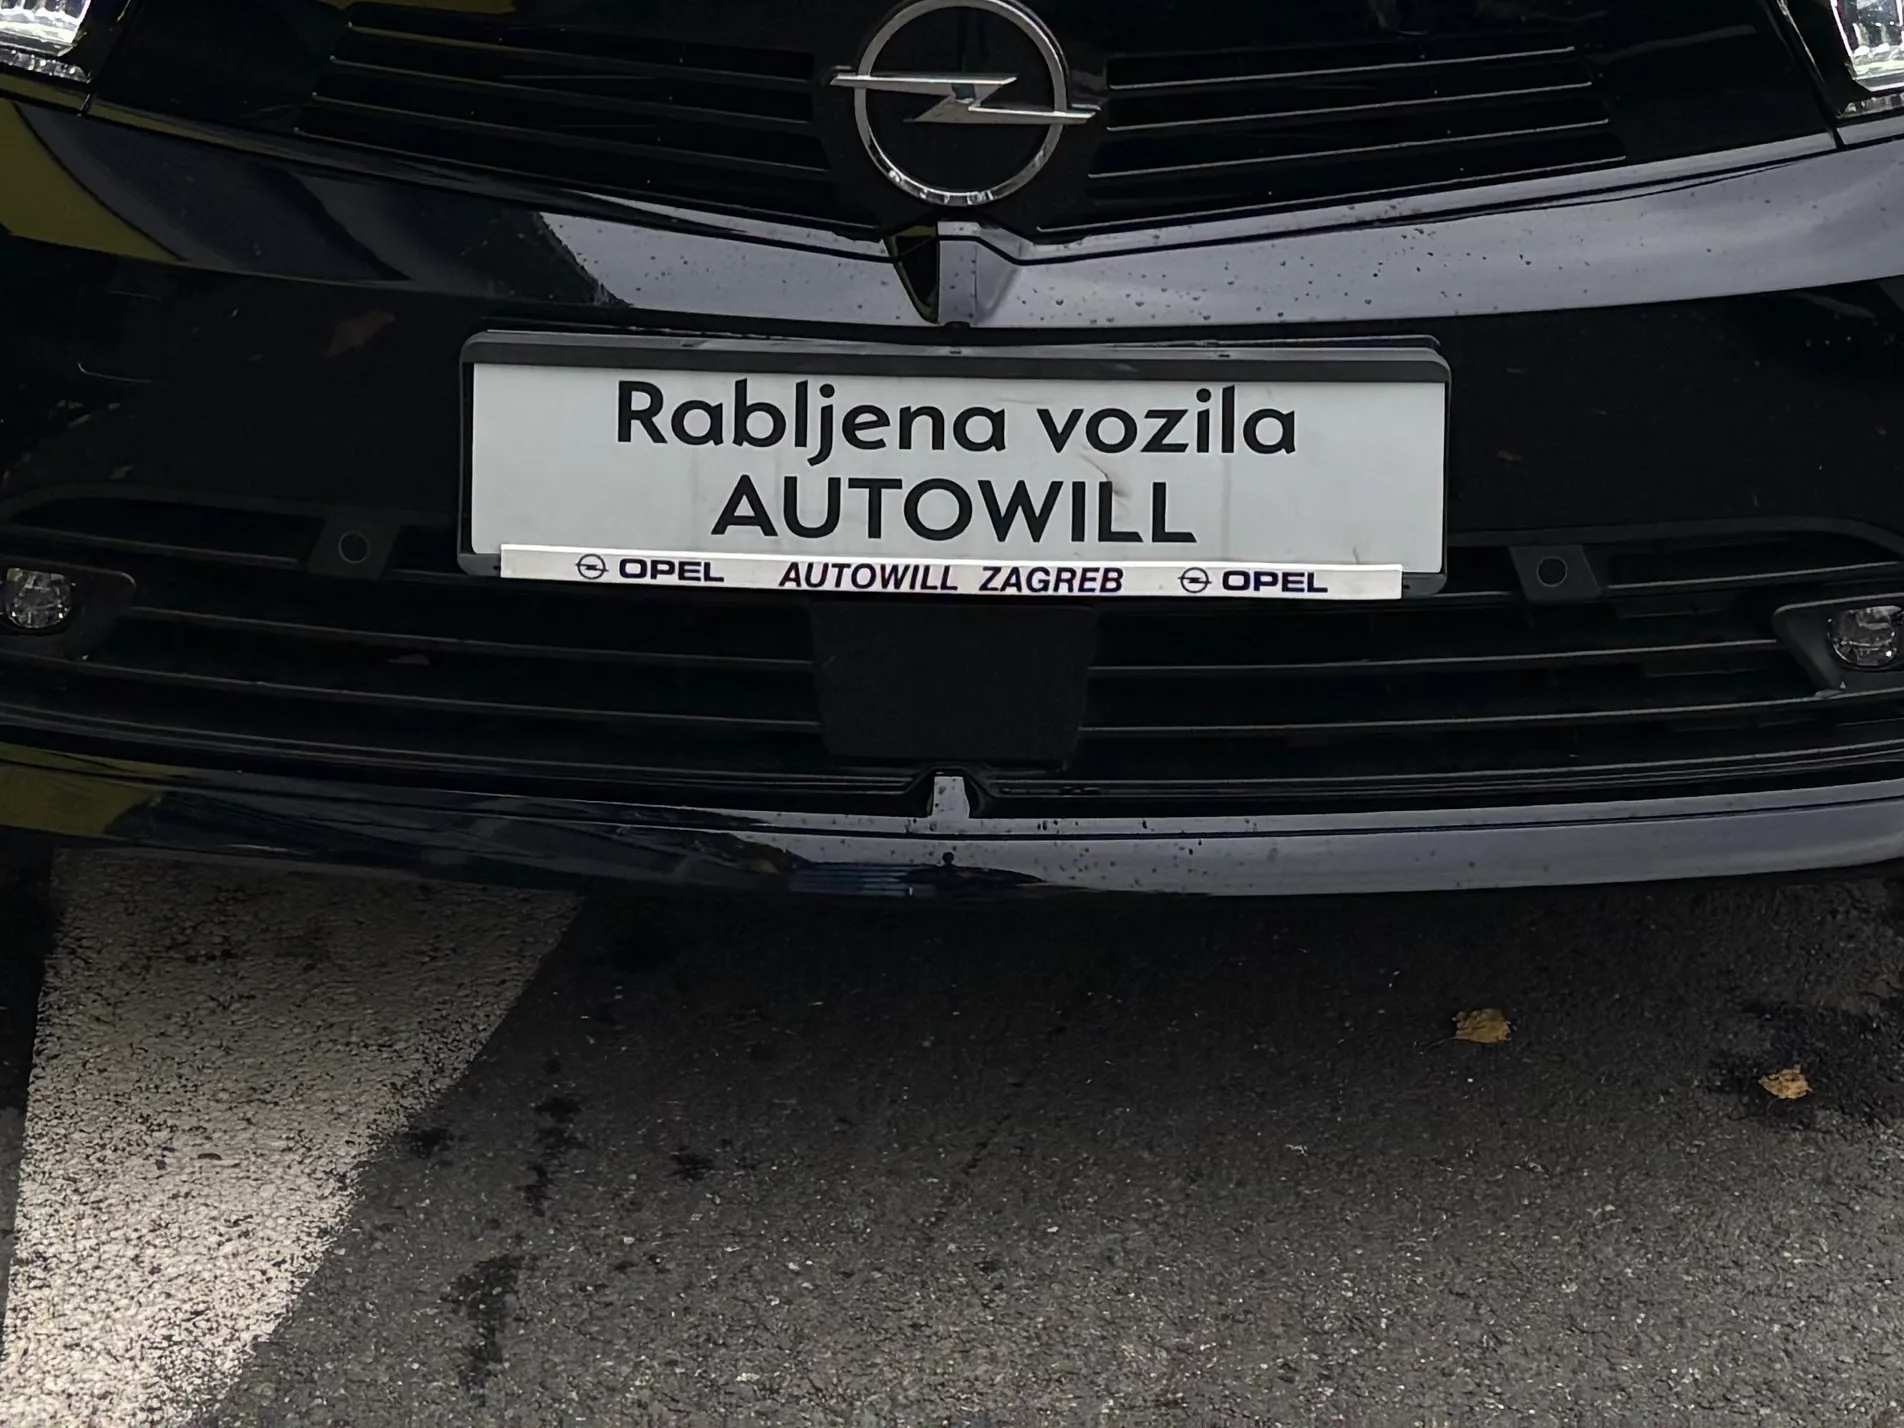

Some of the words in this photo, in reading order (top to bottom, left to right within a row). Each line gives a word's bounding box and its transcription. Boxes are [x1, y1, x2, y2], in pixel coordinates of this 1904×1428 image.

[617, 378, 1007, 467] Rabljena
[1035, 384, 1297, 455] vozila
[710, 474, 1197, 543] AUTOWILL
[619, 558, 725, 583] OPEL
[779, 561, 959, 592] AUTOWILL
[978, 566, 1124, 594] ZAGREB
[1222, 570, 1329, 593] OPEL
